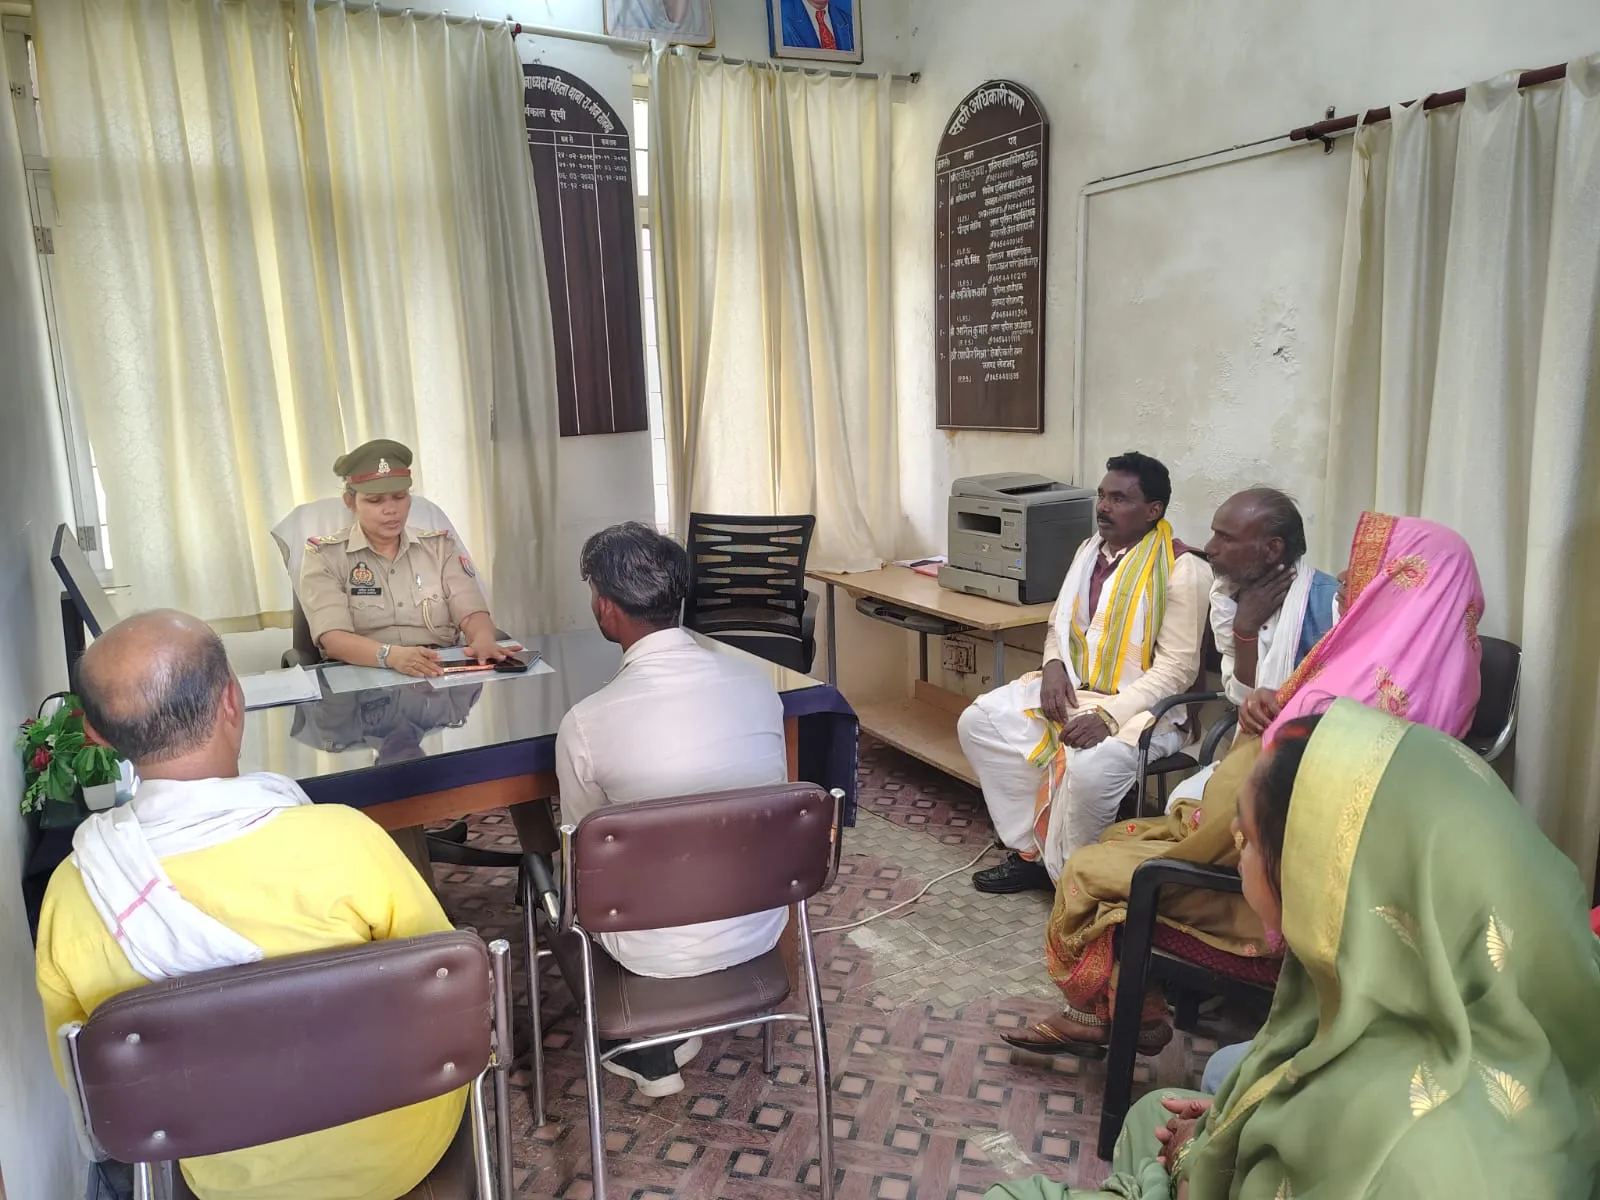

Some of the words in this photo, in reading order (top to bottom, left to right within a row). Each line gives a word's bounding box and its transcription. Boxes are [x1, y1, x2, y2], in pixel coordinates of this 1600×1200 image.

[547, 76, 570, 97] महिला
[568, 86, 586, 104] थाना
[550, 107, 566, 123] सूची
[948, 104, 971, 136] सूची
